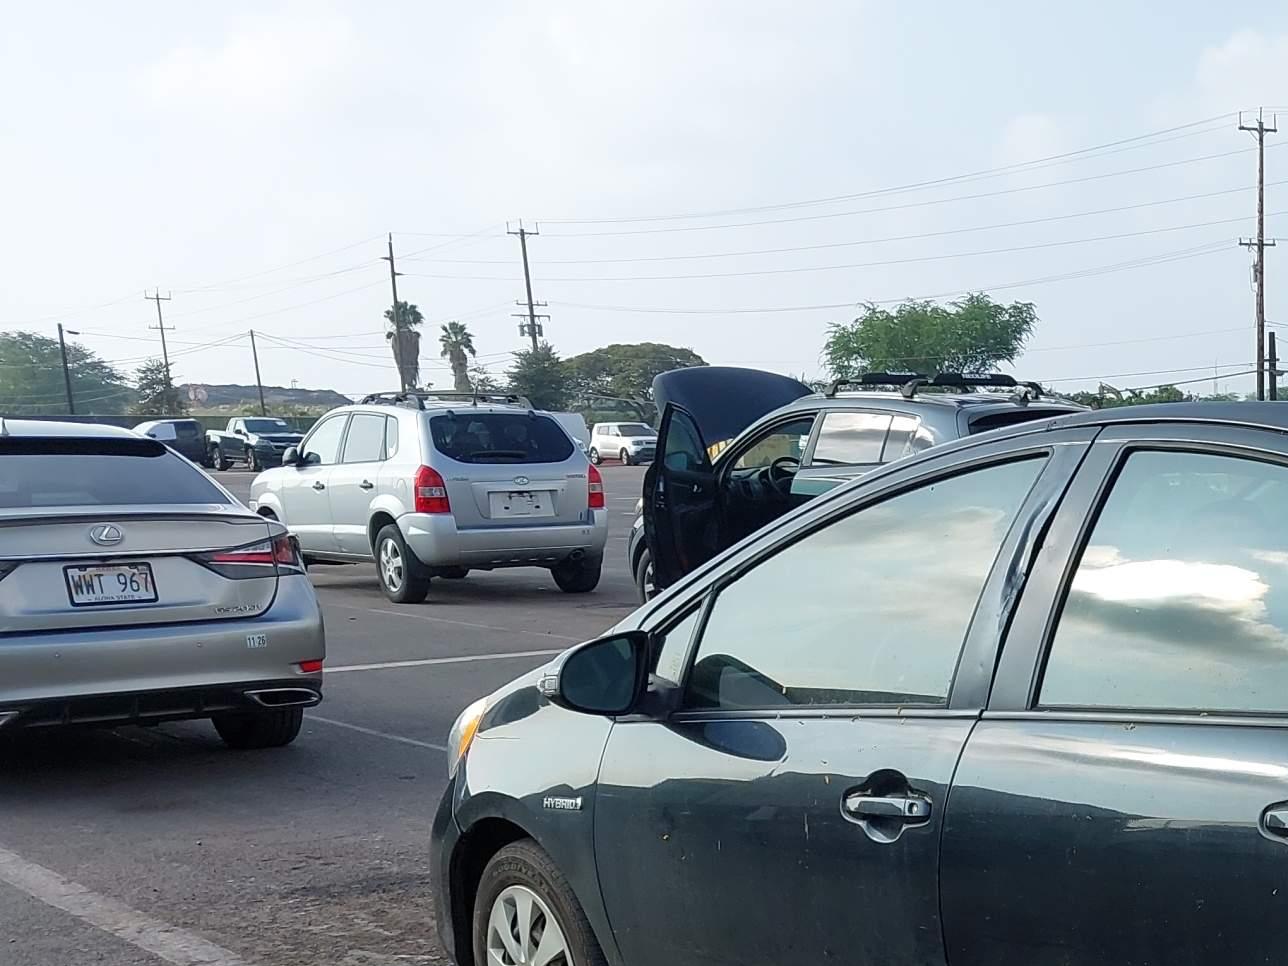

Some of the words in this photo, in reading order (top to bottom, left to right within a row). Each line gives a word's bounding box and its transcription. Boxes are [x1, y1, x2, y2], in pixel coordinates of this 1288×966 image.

[70, 574, 104, 596] WWT
[117, 572, 149, 593] 967
[543, 797, 576, 810] HYBRID
